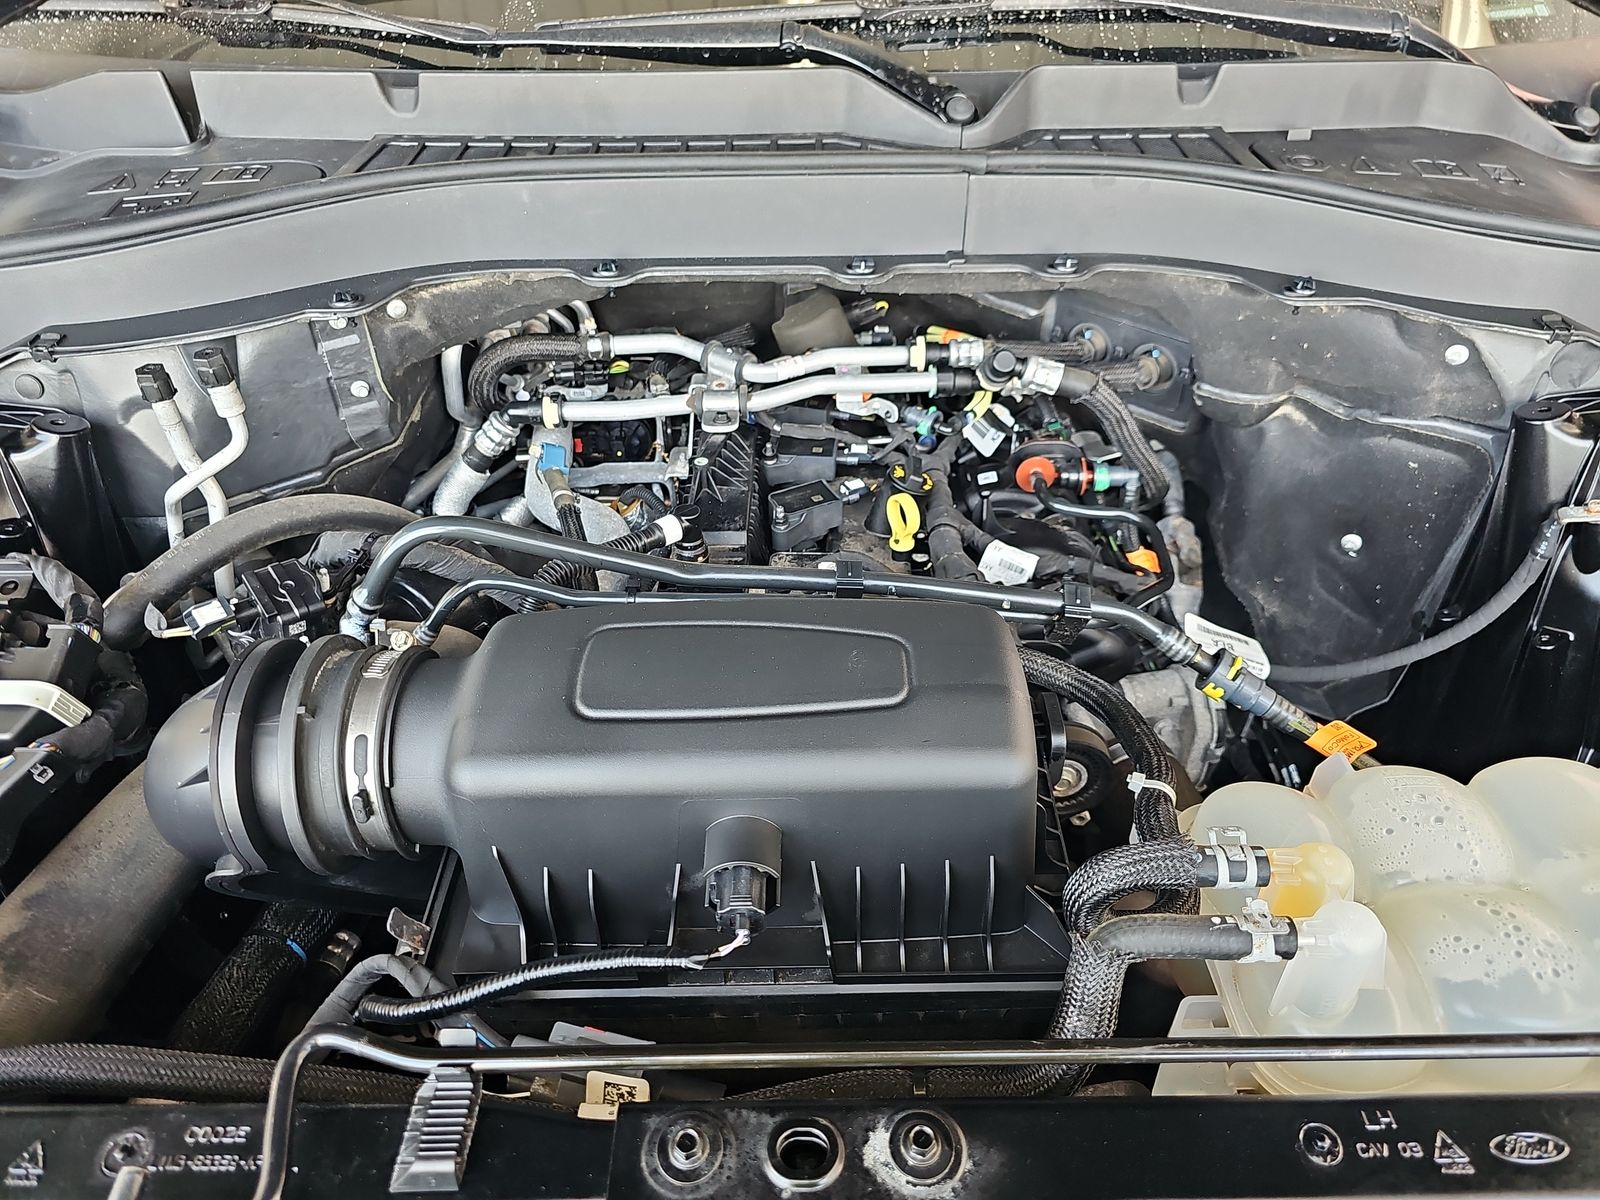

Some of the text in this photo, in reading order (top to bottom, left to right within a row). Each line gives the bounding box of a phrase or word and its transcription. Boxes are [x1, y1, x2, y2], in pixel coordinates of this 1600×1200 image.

[1327, 732, 1355, 751] FoMoCo
[1360, 1110, 1398, 1130] LH
[1356, 1142, 1390, 1158] CAV
[1504, 1135, 1558, 1158] Ford
